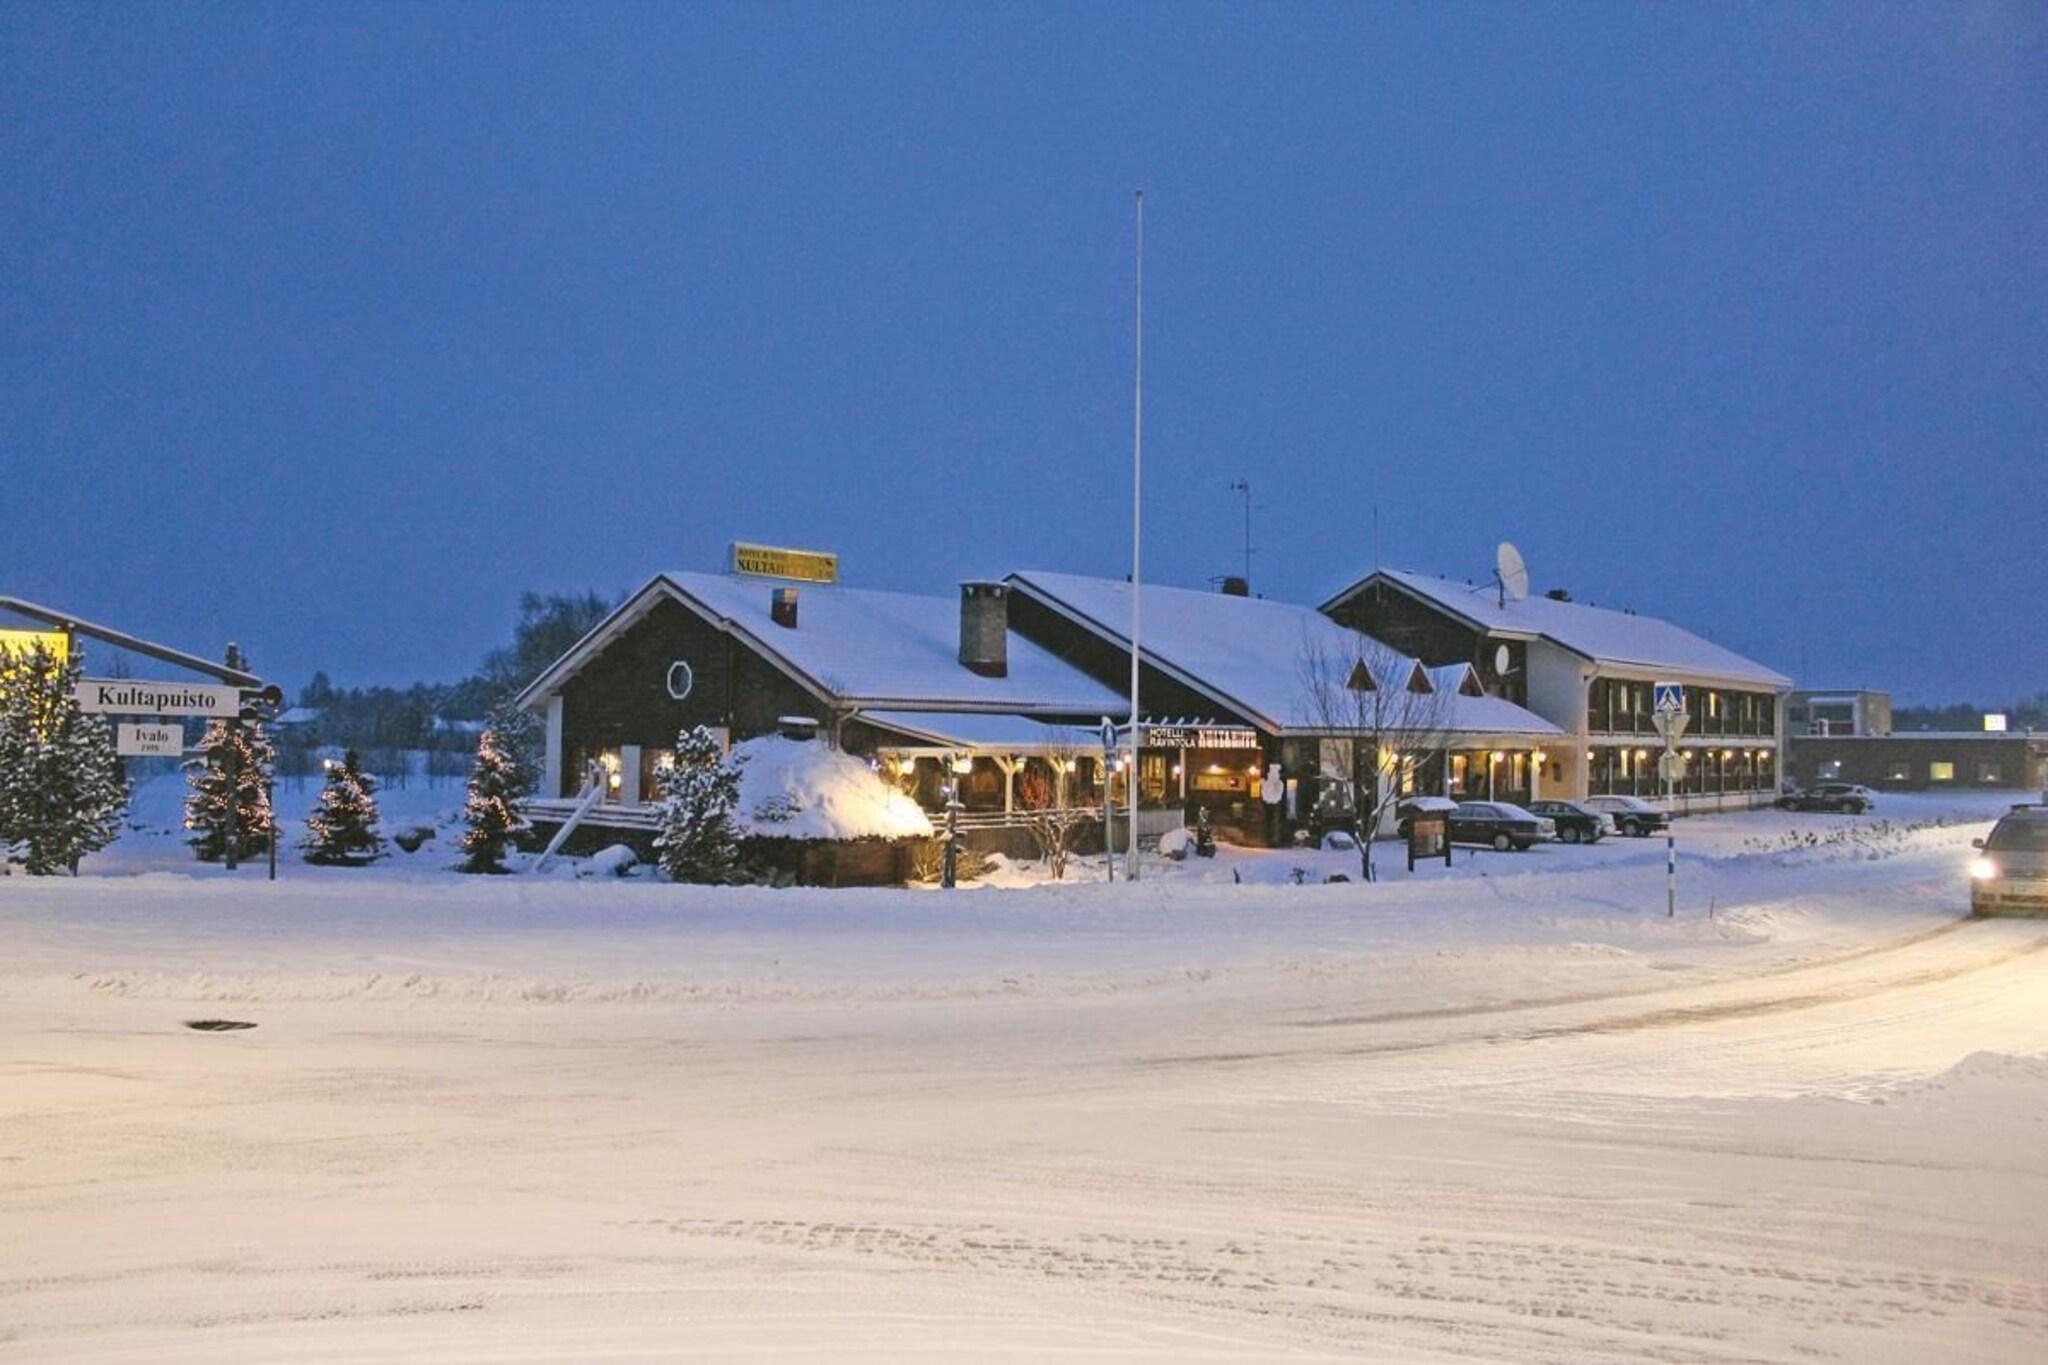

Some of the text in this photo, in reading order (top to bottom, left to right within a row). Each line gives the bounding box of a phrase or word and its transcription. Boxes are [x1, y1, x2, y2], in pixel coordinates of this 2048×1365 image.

[98, 686, 216, 711] Kultapuisto
[135, 729, 169, 742] Ivalo
[1150, 728, 1184, 738] HOTELLI
[1149, 738, 1195, 747] RAVINTOLA
